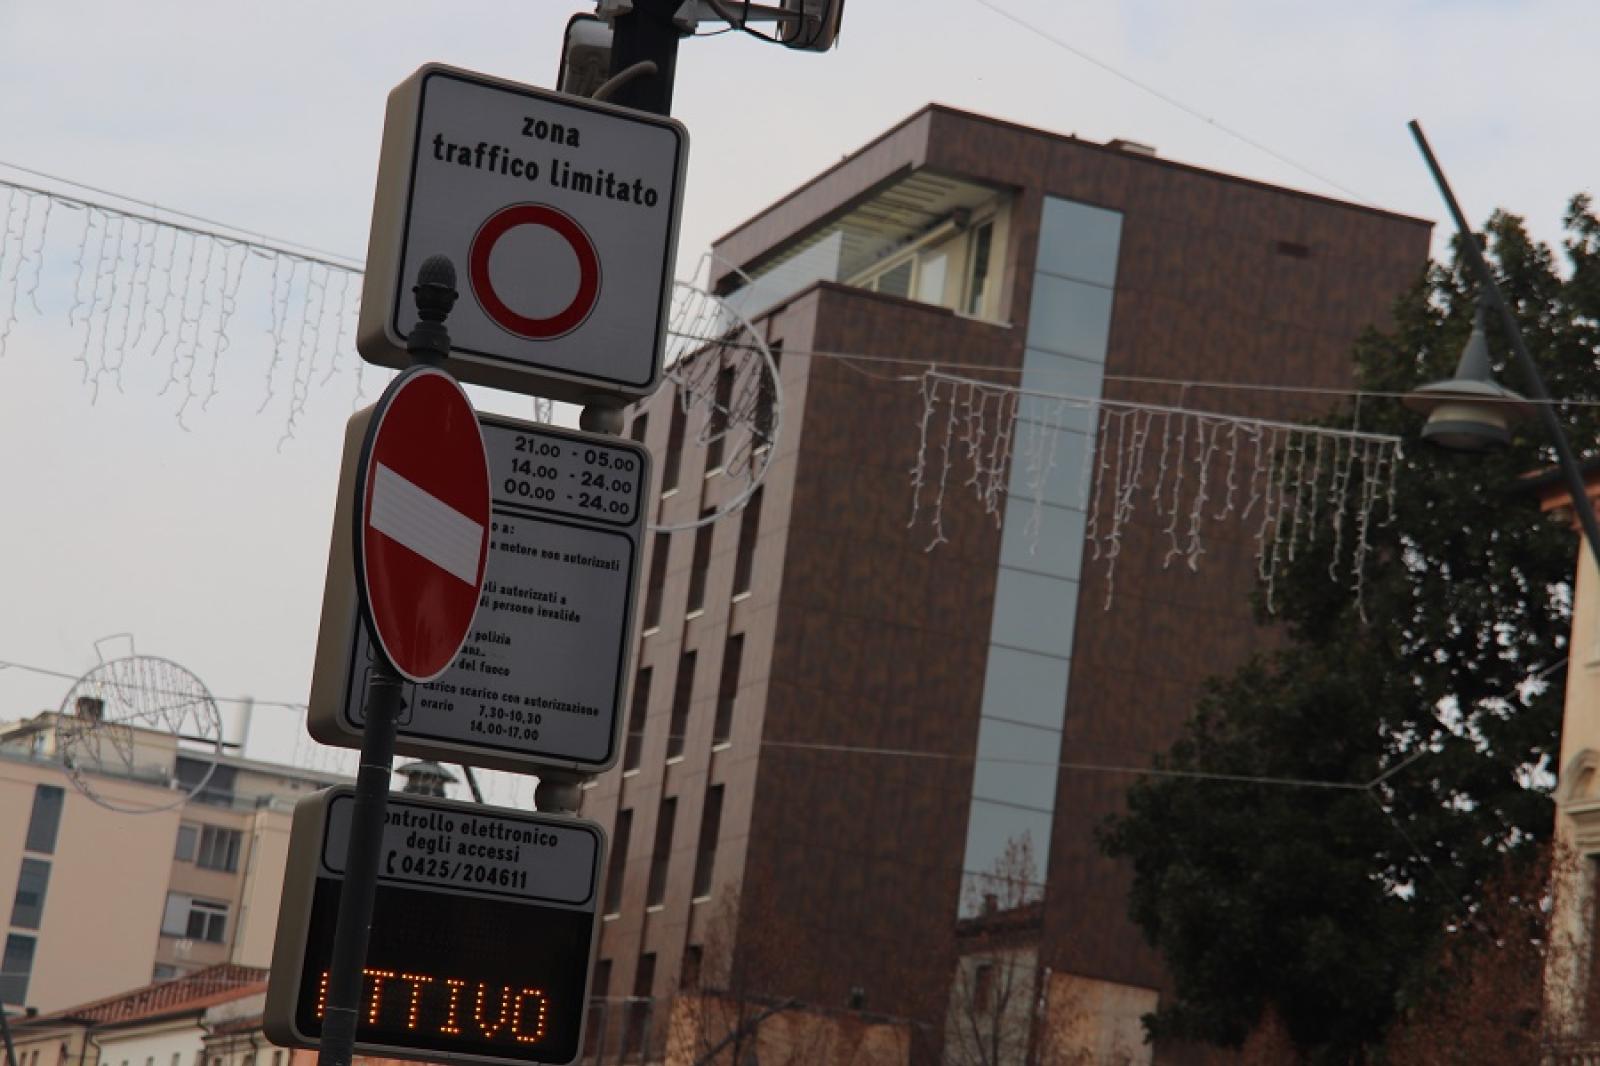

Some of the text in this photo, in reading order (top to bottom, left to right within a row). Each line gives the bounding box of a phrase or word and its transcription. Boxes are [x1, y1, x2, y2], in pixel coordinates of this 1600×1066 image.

[521, 116, 581, 148] zona
[433, 133, 659, 207] traffico limitato
[514, 435, 561, 458] 21.00
[584, 449, 634, 472] 05.00
[511, 457, 558, 480] 14.00
[581, 471, 632, 494] 24.00
[504, 478, 555, 501] 00.00
[578, 492, 630, 515] 24.00
[502, 523, 516, 535] a:
[500, 541, 538, 557] motore
[541, 549, 561, 562] non
[563, 553, 620, 571] autorizzati
[500, 584, 558, 605] autorizzati
[492, 600, 534, 616] persone
[536, 604, 581, 623] invalide
[475, 631, 511, 646] polizia
[458, 658, 476, 672] del
[479, 661, 511, 677] fuoco
[420, 697, 455, 712] orario
[460, 686, 499, 702] scarico
[502, 692, 520, 705] con
[523, 696, 600, 717] autorizzazione
[470, 719, 540, 742] 14.00-17.00
[406, 831, 520, 863] degli accessi
[461, 818, 558, 847] elettronico
[401, 854, 528, 890] 0425/204611
